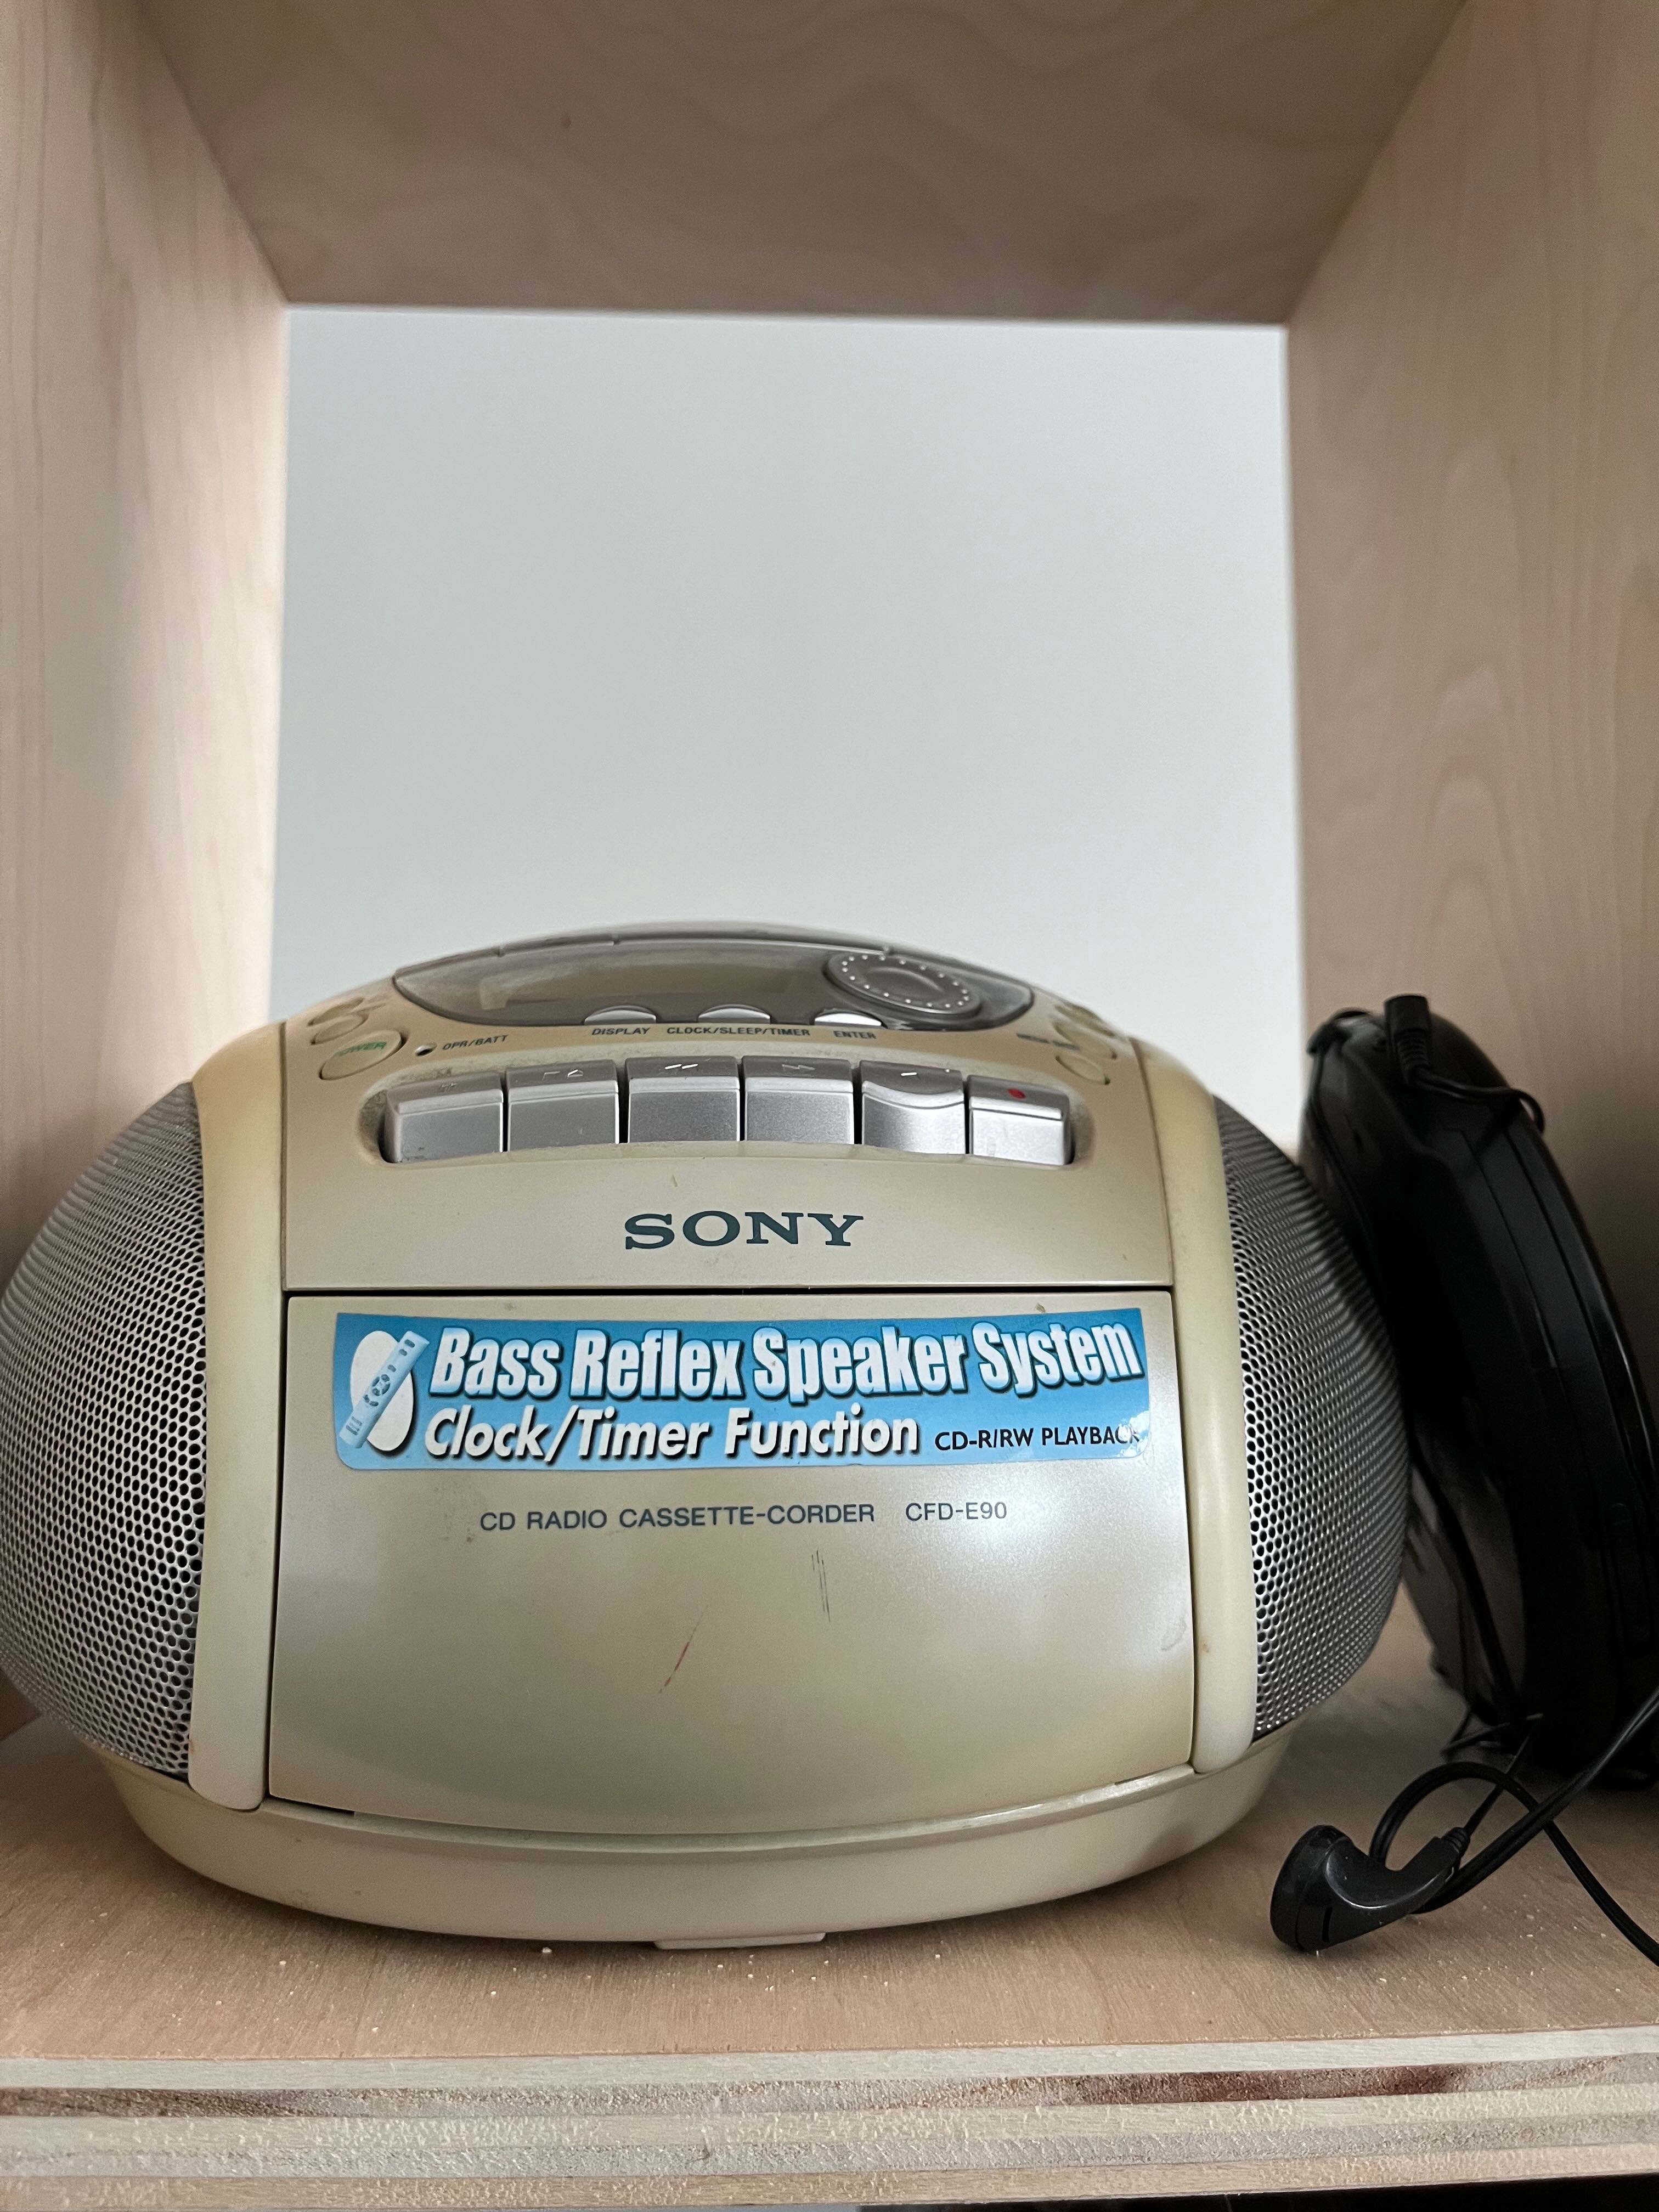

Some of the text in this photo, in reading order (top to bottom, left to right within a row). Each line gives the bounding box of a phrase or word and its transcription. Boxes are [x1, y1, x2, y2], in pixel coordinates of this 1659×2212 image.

[442, 1035, 509, 1050] OPR/BATT
[591, 1027, 651, 1036] DISPLAY
[666, 1027, 810, 1037] CLOCK/SLEEP/TIMER
[833, 1030, 877, 1040] ENTER
[625, 1210, 864, 1249] SONY
[430, 1322, 1146, 1404] Bass Reflex Speaker System
[425, 1403, 919, 1463] Clock/Timer Function
[934, 1427, 1034, 1451] CD-R/RW
[480, 1502, 1007, 1531] CD RADIO CASSETTE-CORDER CFD-E90
